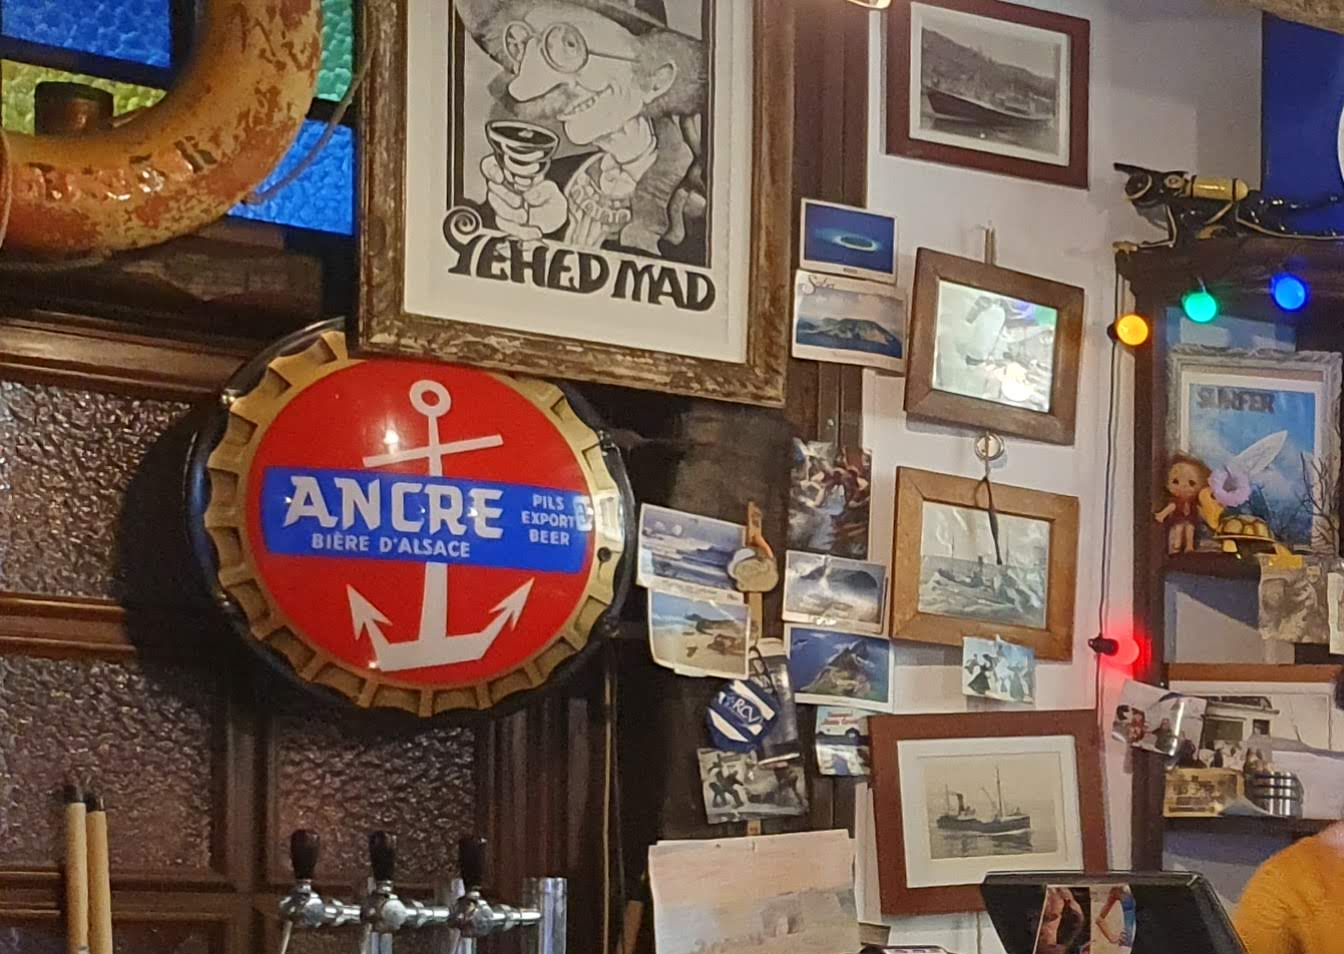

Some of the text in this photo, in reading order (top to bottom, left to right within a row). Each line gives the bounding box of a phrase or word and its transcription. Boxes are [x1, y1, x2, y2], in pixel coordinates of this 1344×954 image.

[442, 205, 717, 312] YEHED MAD
[282, 475, 505, 540] ANCRE
[532, 492, 566, 511] PILS
[521, 511, 576, 529] EXPORT
[311, 530, 471, 559] BIÈRE D'ALSACE
[528, 528, 571, 546] BEER
